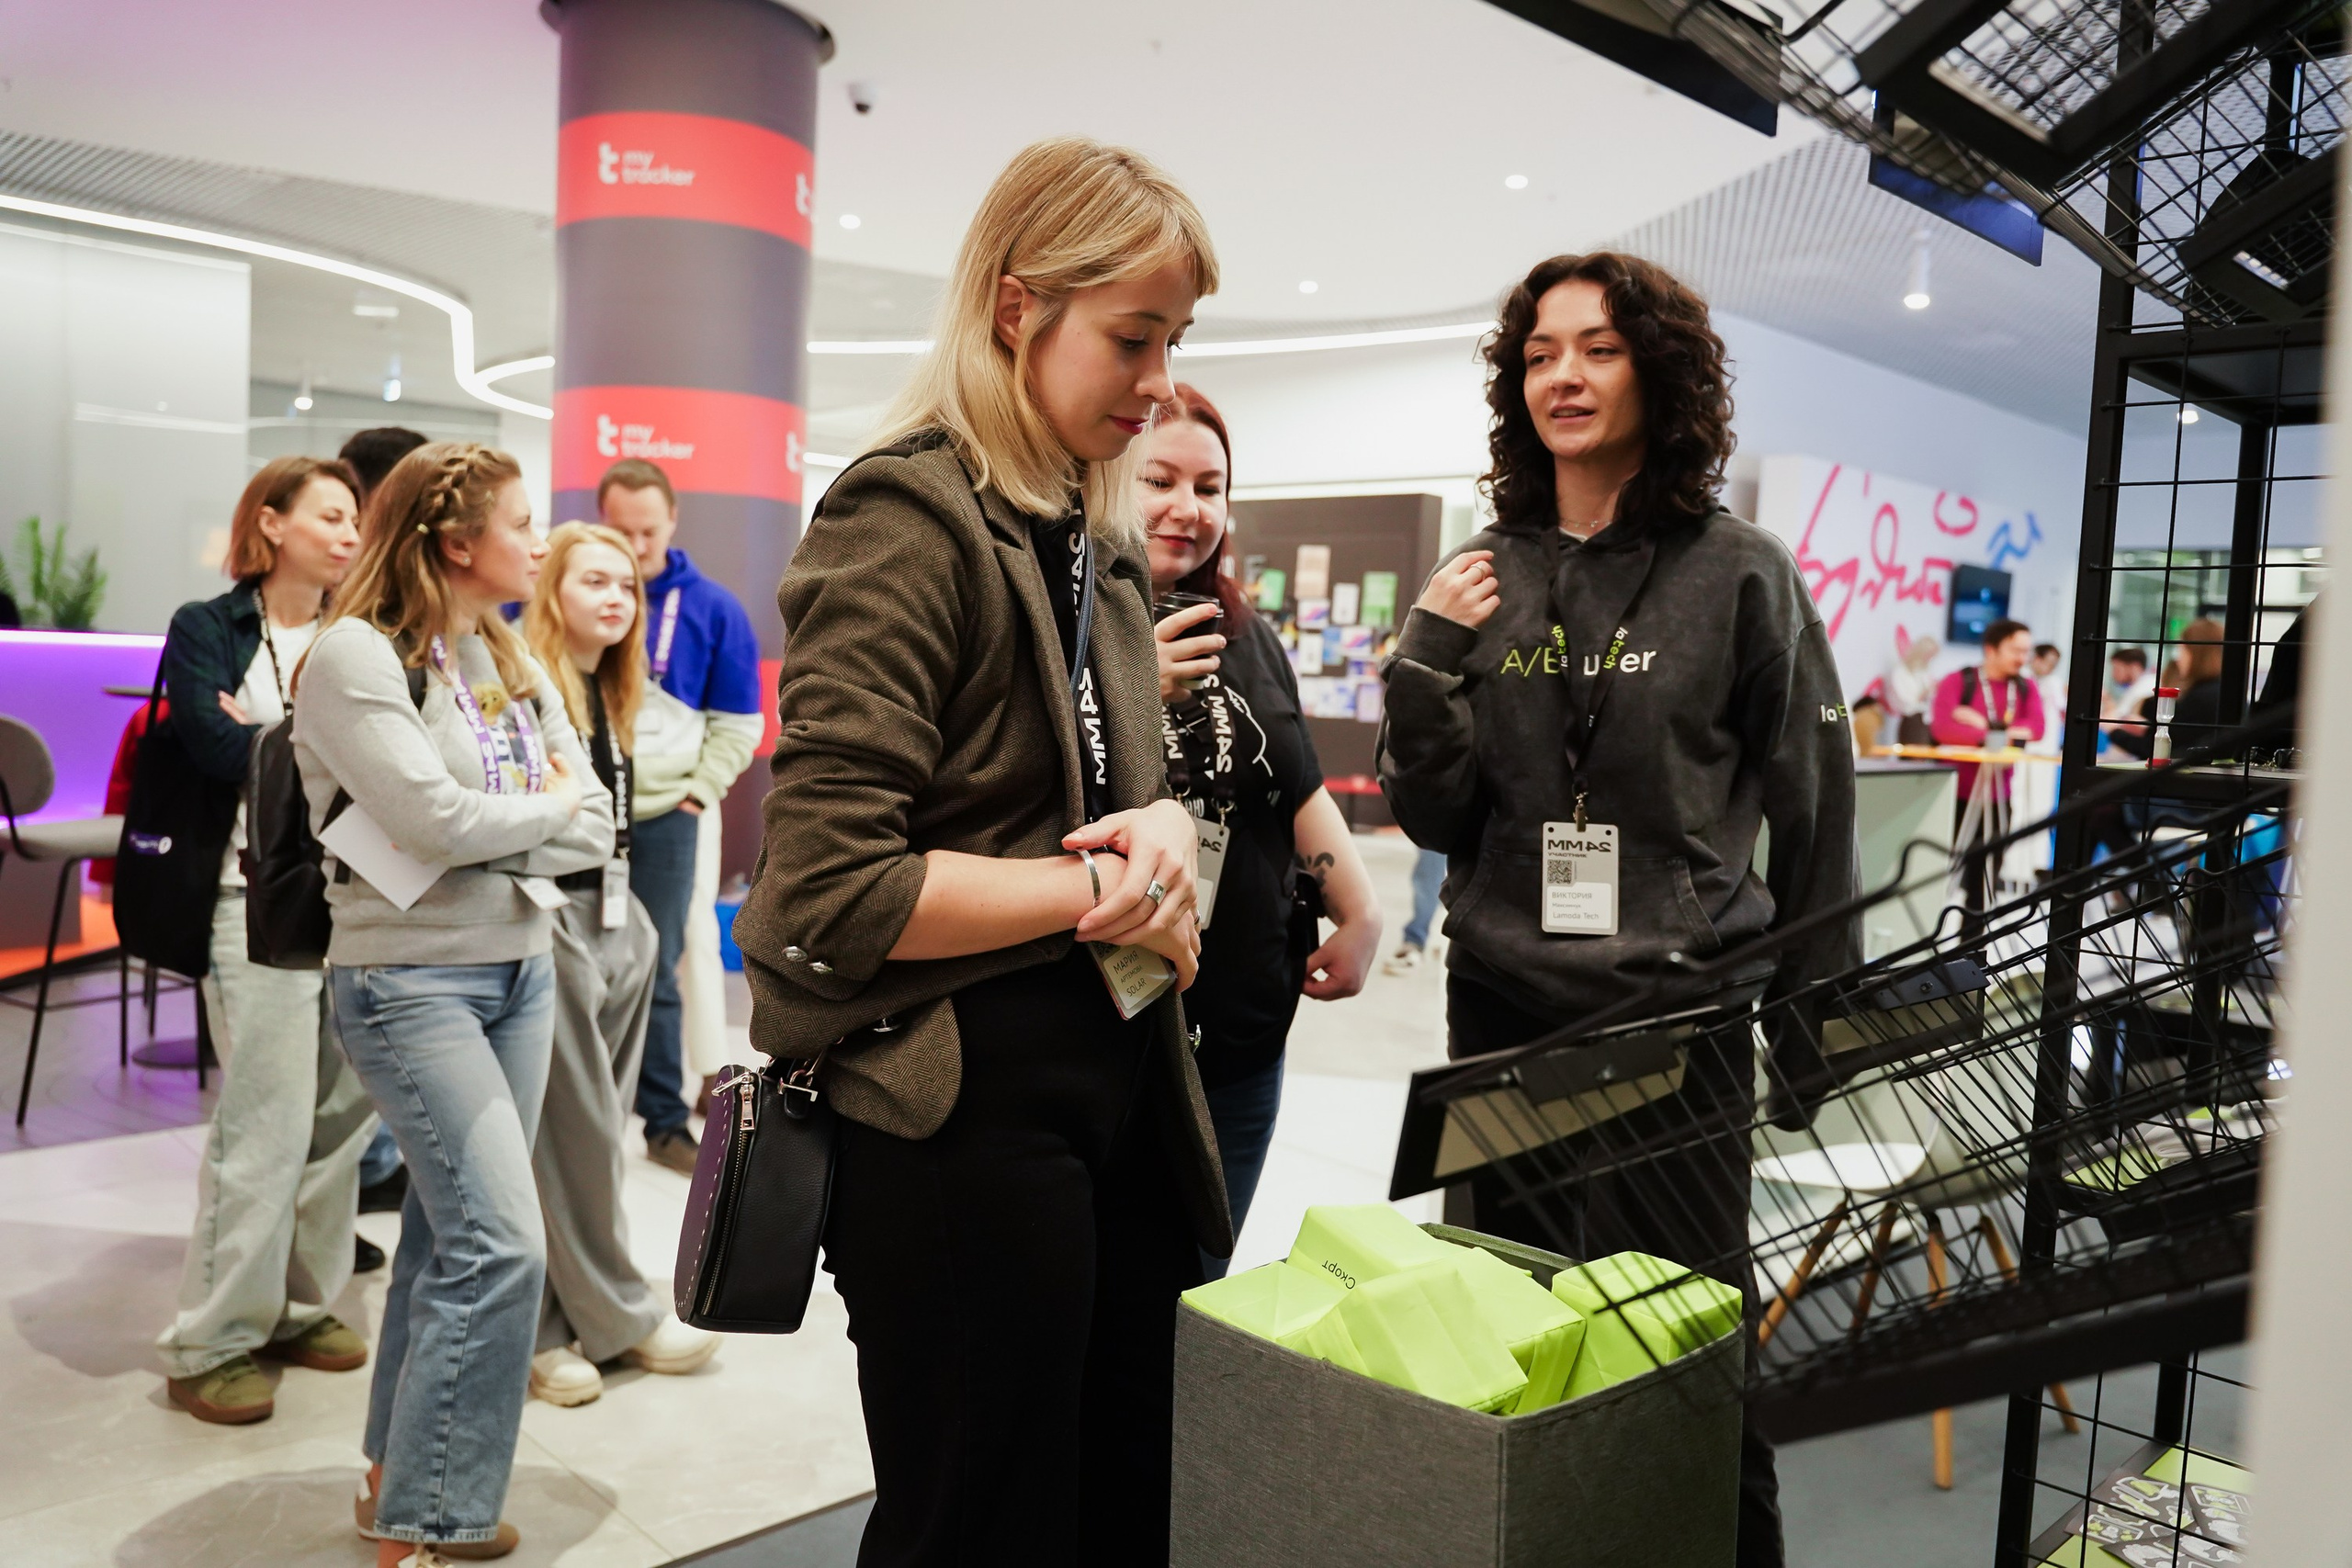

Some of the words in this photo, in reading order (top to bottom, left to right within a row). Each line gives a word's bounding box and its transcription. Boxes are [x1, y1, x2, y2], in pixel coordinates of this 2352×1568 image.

[622, 150, 654, 169] my
[622, 164, 695, 186] tracker
[621, 423, 654, 443] my
[621, 438, 695, 459] tracker
[1582, 650, 1657, 676] uer
[1552, 891, 1592, 899] ВИКТОРИЯ
[1113, 950, 1139, 975] МАРИЯ
[1126, 977, 1147, 998] SOLAR
[1321, 1259, 1356, 1290] Скорт
